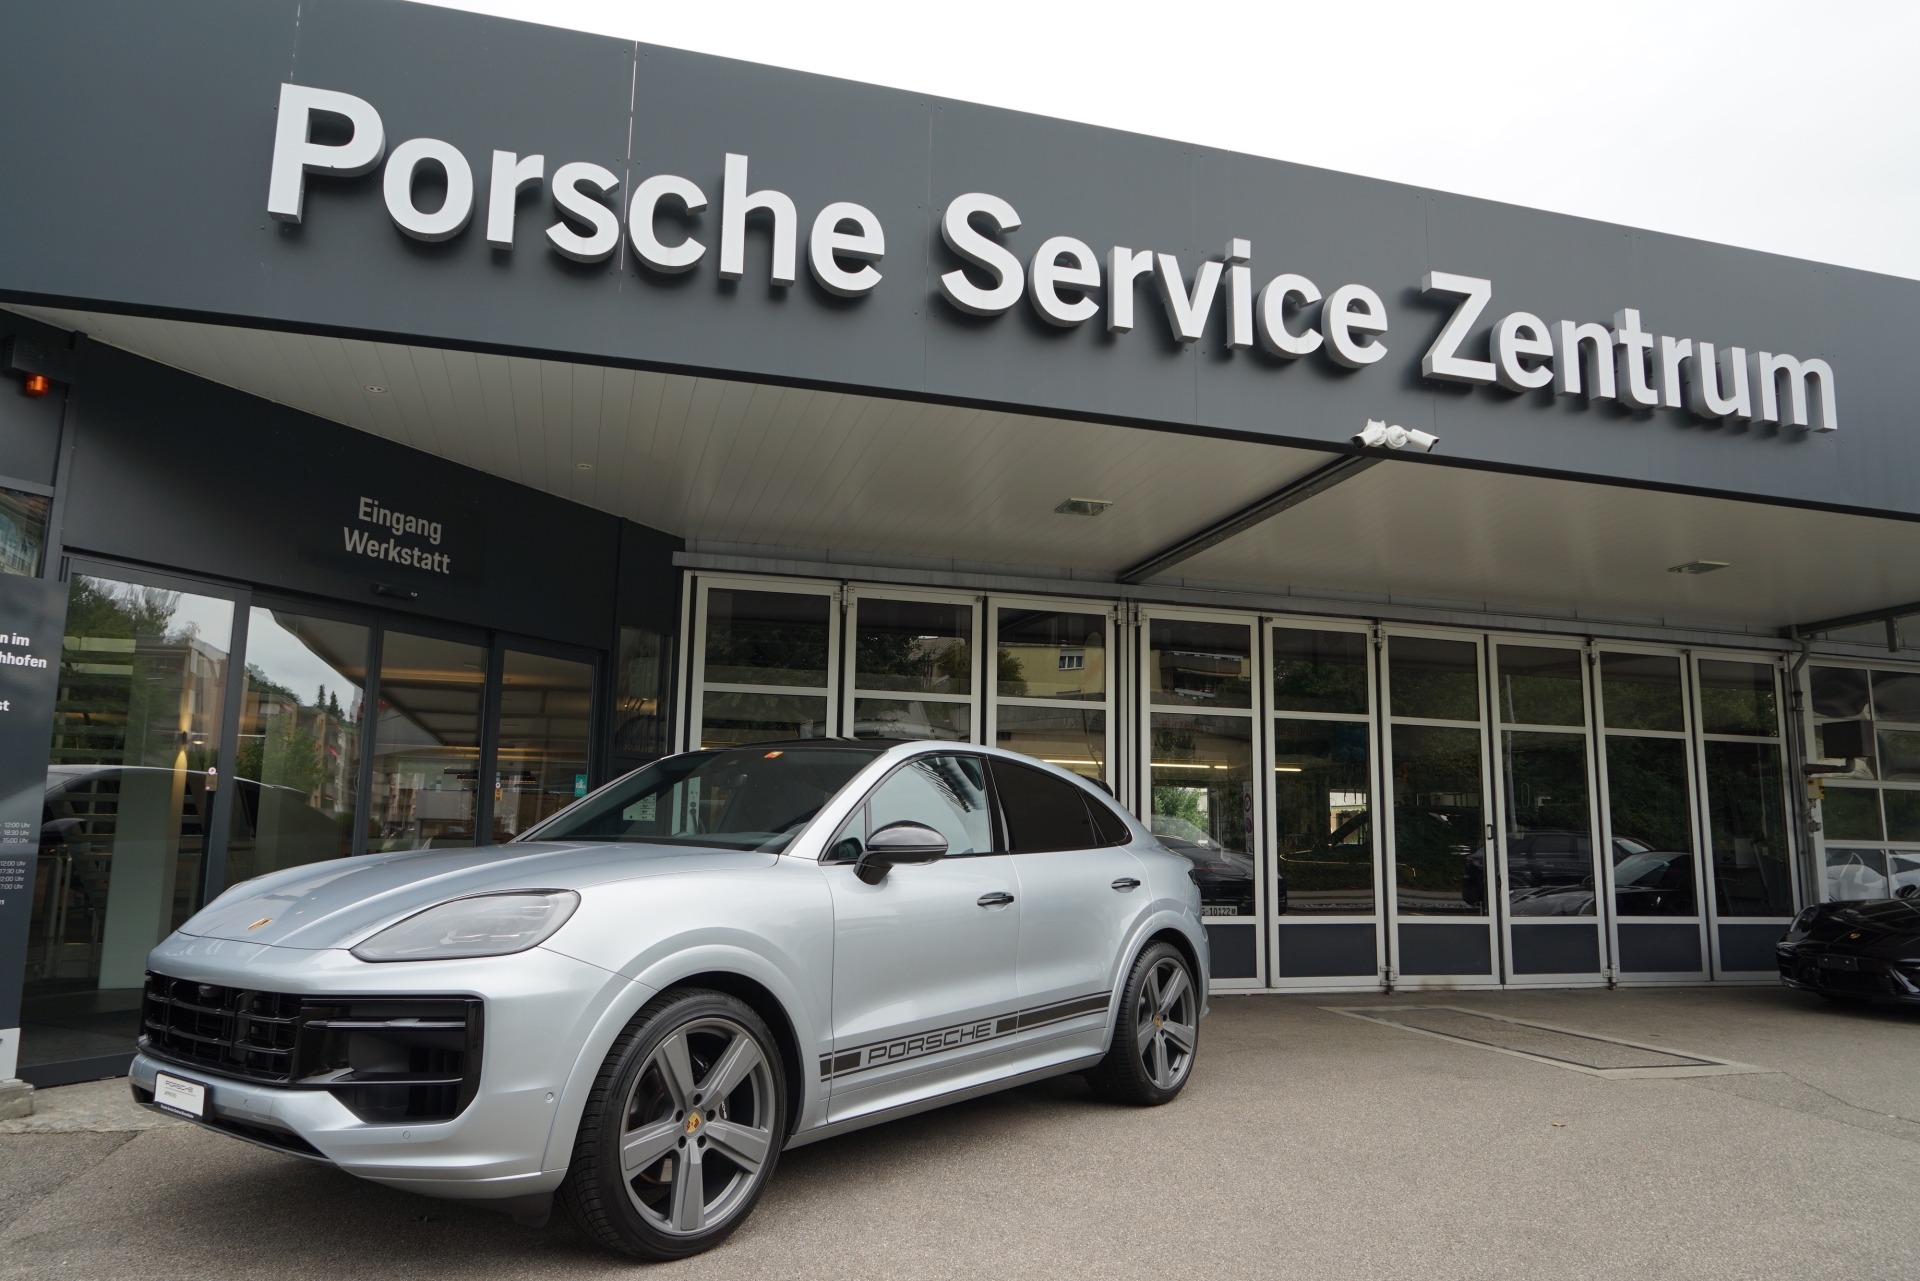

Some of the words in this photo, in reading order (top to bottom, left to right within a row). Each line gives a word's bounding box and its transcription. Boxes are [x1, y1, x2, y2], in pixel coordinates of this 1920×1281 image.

[267, 83, 886, 297] Porsche
[938, 192, 1388, 369] Service
[1421, 271, 1838, 433] Zentrum
[358, 496, 442, 545] Eingang
[343, 526, 451, 574] Werkstatt
[11, 632, 30, 646] im
[868, 1022, 992, 1064] PORSCHE
